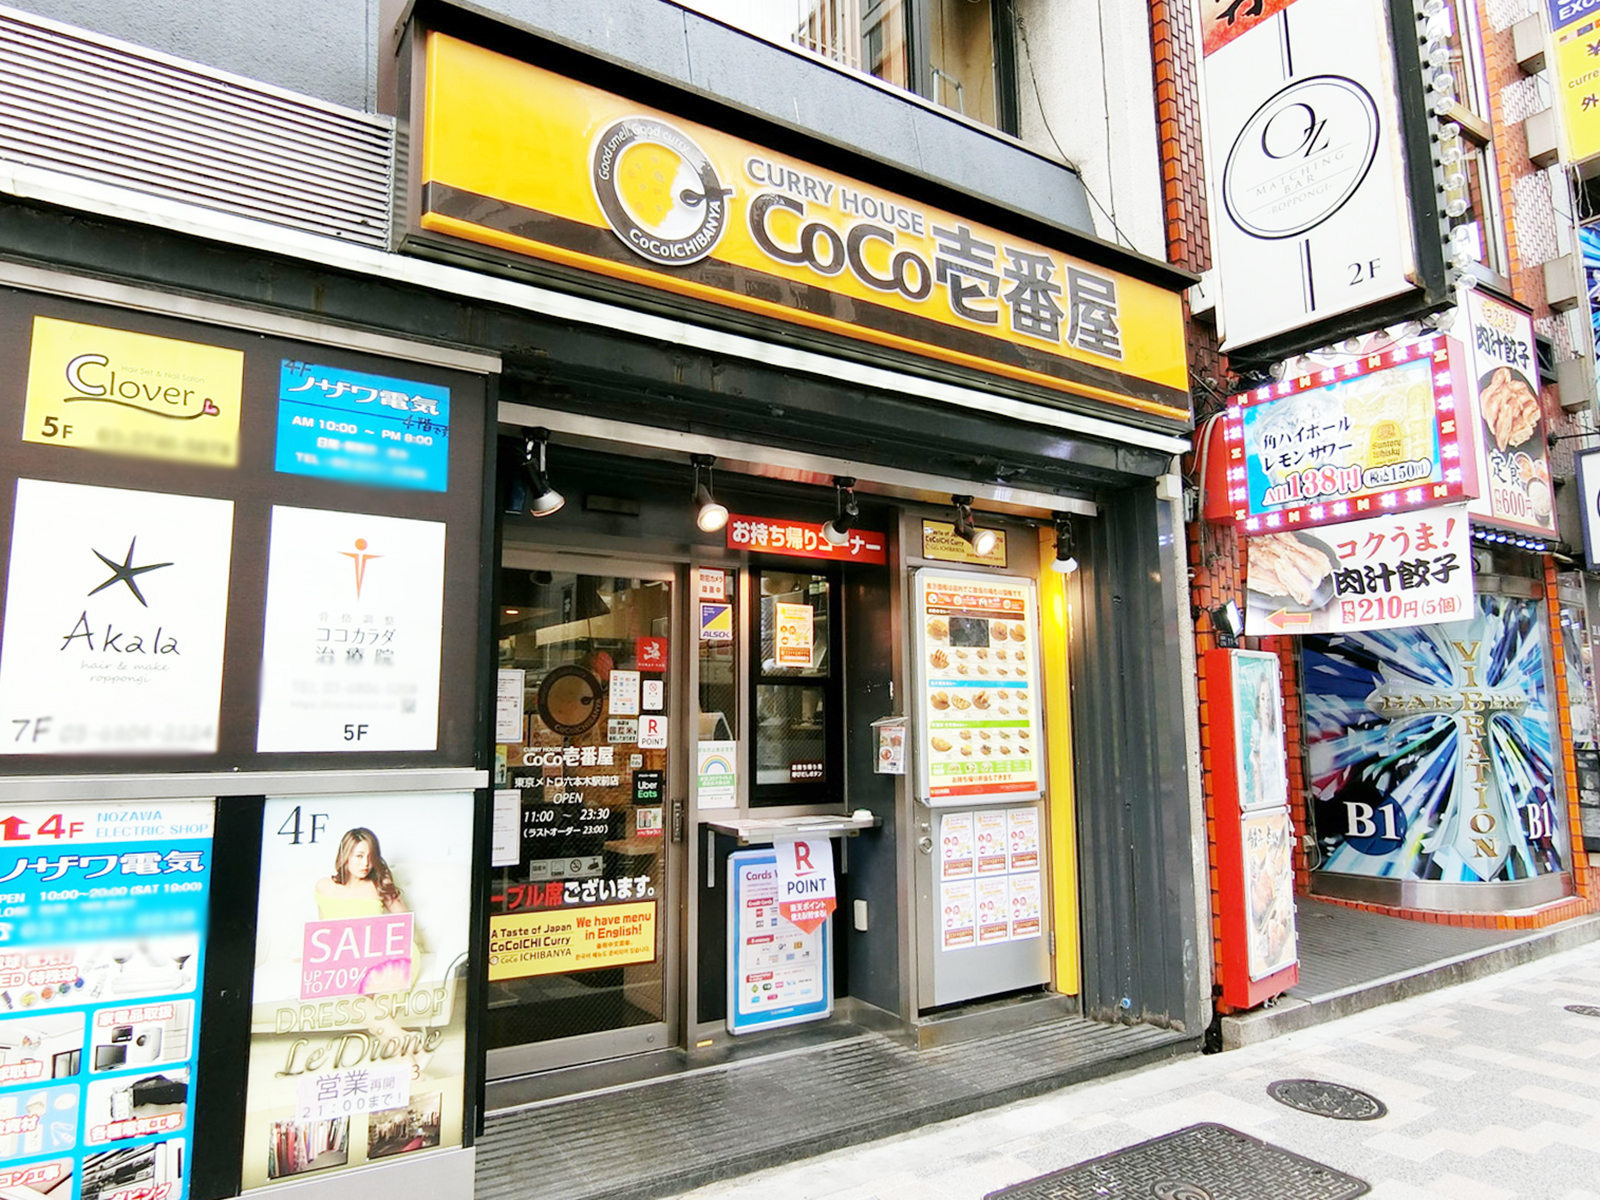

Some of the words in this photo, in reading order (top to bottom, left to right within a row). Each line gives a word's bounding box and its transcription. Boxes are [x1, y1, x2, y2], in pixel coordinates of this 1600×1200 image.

[1256, 151, 1344, 197] MATCHING
[1284, 174, 1315, 194] BAR
[747, 158, 834, 202] CURRY
[842, 187, 924, 235] HOUSE
[748, 193, 1123, 360] CoCo壱番屋
[1348, 258, 1381, 286] 2F
[66, 353, 195, 407] Clover
[287, 376, 440, 416] ノザワ電気
[291, 415, 315, 428] AM
[319, 419, 358, 434] 10:00
[381, 430, 402, 441] PM
[404, 433, 433, 446] 8:00
[1263, 443, 1353, 472] レモンサワー
[1332, 552, 1460, 596] 肉汁餃子
[1357, 595, 1418, 622] 210円
[60, 610, 181, 656] Akala
[316, 627, 397, 646] ココカラダ
[702, 630, 730, 639] ALSOK
[343, 724, 369, 742] 5F
[648, 719, 658, 734] R
[641, 737, 665, 746] POINT
[1450, 640, 1500, 859] VIBRATION
[523, 745, 614, 767] CoCo壱番屋
[514, 775, 620, 789] 東京メトロ六本木駅前店
[637, 781, 658, 790] Uber
[553, 792, 584, 805] OPEN
[637, 790, 658, 799] Eats
[97, 810, 163, 823] NOZAWA
[277, 805, 329, 845] 4F
[524, 809, 554, 823] 11:00
[579, 807, 611, 821] 23:30
[1343, 800, 1401, 841] B1
[1526, 802, 1552, 840] B1
[37, 813, 85, 839] 4F
[96, 824, 166, 838] ELECTRIC
[169, 823, 209, 836] SHOP
[794, 840, 814, 871] R
[0, 850, 206, 884] ノザワ電気
[745, 869, 772, 881] Cards
[787, 877, 827, 895] POINT
[576, 916, 592, 928] We
[594, 915, 621, 927] have
[622, 912, 652, 924] menu
[491, 929, 498, 939] A
[500, 926, 530, 938] Taste
[531, 924, 542, 935] of
[543, 923, 573, 934] Japan
[543, 936, 572, 947] Curry
[585, 929, 596, 941] in
[597, 923, 643, 940] English!
[308, 922, 406, 964] SALE
[519, 947, 572, 962] ICHIBANYA
[303, 969, 322, 982] UP
[303, 981, 324, 994] TO
[275, 997, 367, 1035] DRESS
[374, 986, 448, 1021] SHOP
[316, 1068, 396, 1101] 営業再開
